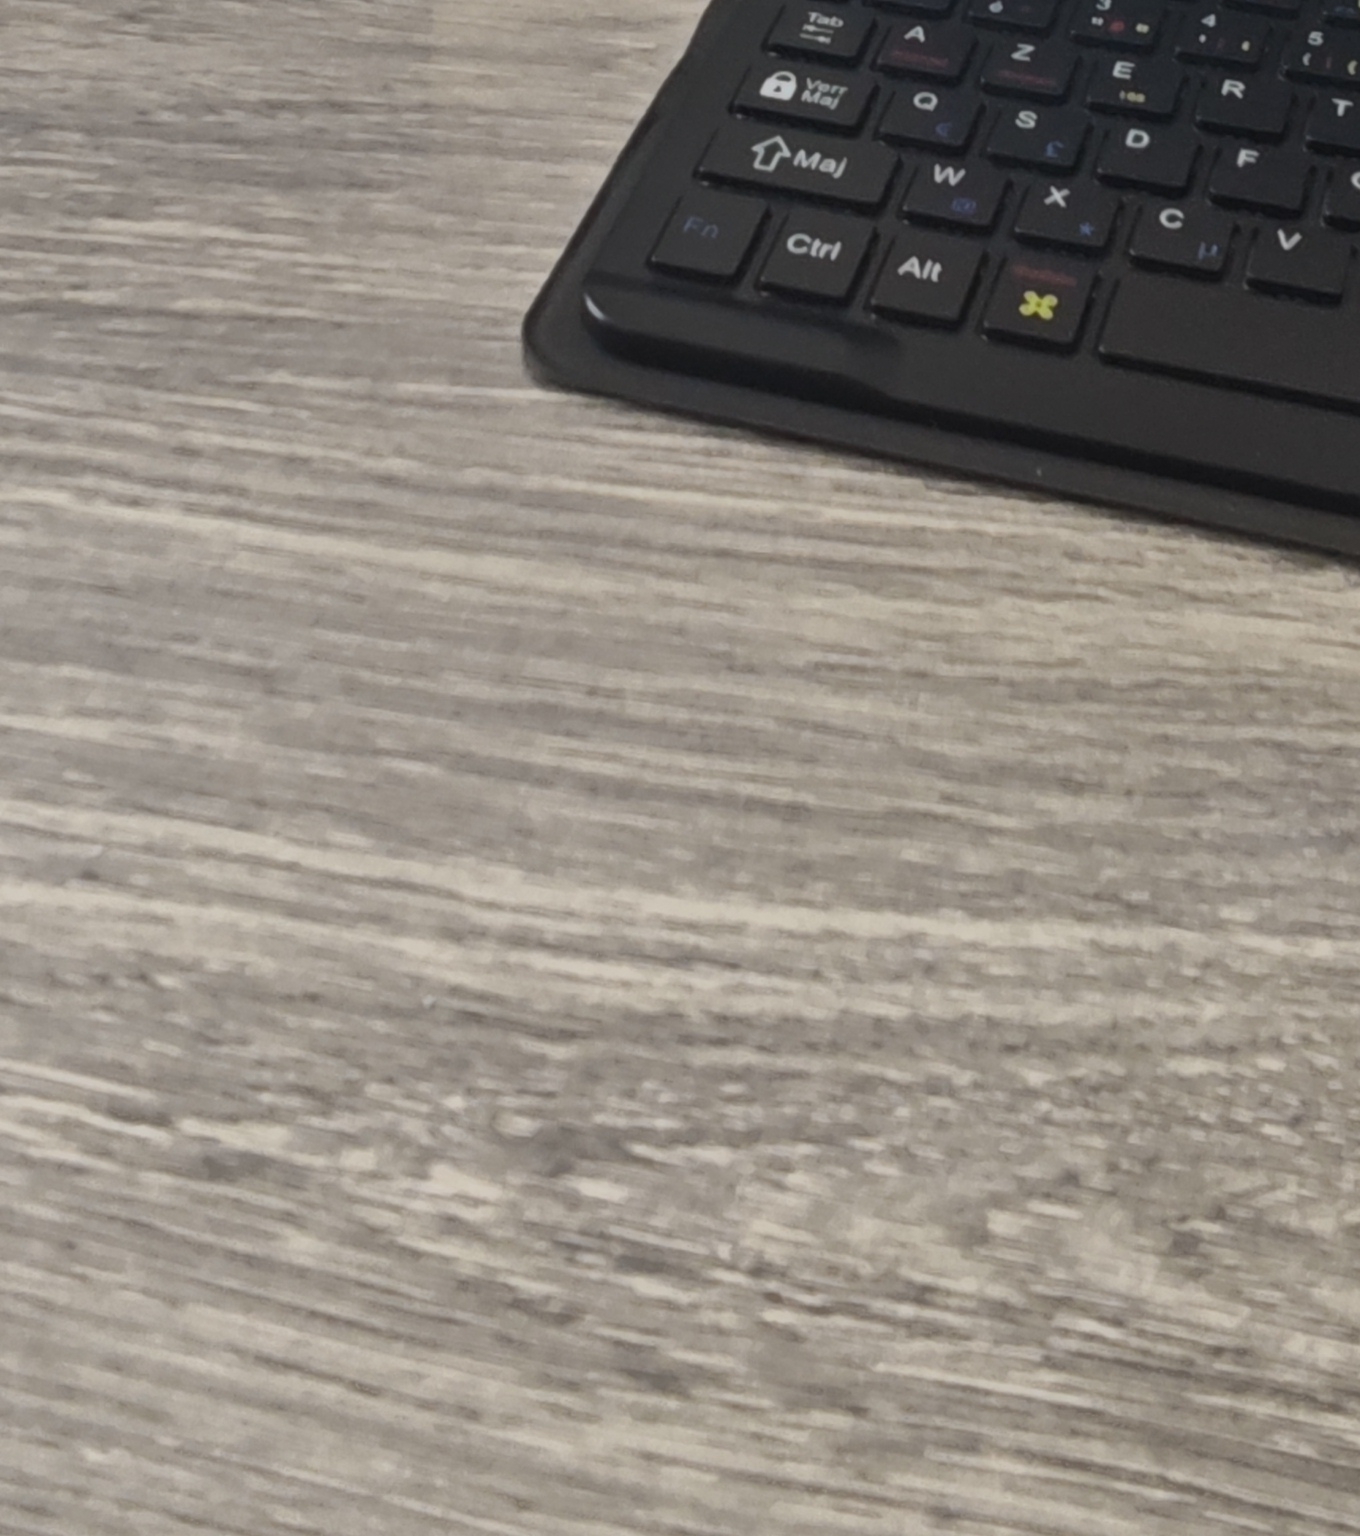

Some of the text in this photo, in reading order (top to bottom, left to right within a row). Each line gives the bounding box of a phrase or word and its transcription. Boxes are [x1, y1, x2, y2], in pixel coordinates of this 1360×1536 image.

[807, 11, 844, 28] Tab
[1200, 13, 1217, 29] 4
[903, 25, 926, 43] A
[1307, 30, 1324, 46] 5
[1010, 43, 1036, 62] Z
[1112, 60, 1136, 80] E
[1221, 78, 1246, 99] R
[801, 89, 840, 110] Maj
[912, 91, 939, 112] Q
[1331, 98, 1355, 117] T
[1014, 110, 1039, 130] S
[1125, 129, 1149, 149] D
[793, 149, 847, 178] Maj
[1236, 149, 1259, 167] F
[933, 163, 966, 187] W
[1043, 186, 1071, 208] X
[683, 216, 720, 239] Fn
[1159, 208, 1184, 230] C
[786, 233, 842, 262] Ctrl
[1277, 229, 1302, 251] V
[898, 256, 943, 282] Alt
